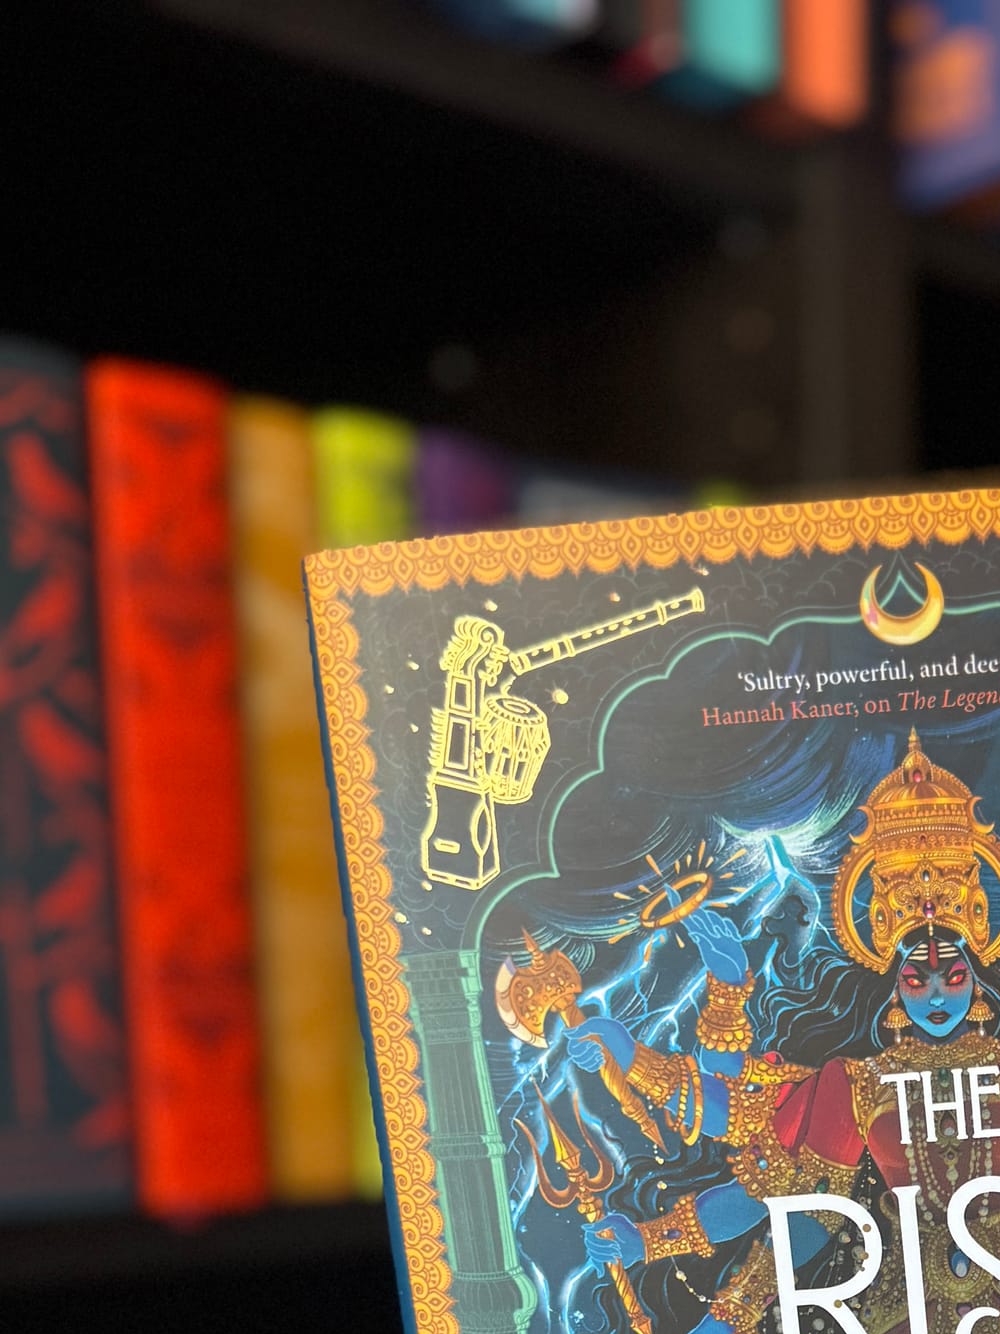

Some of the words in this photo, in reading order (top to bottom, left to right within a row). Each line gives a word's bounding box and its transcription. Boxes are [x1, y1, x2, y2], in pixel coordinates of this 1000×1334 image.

[815, 658, 914, 692] powerful,
[920, 658, 959, 679] and
[702, 703, 785, 727] Hannah
[864, 698, 891, 715] on
[898, 690, 937, 712] The
